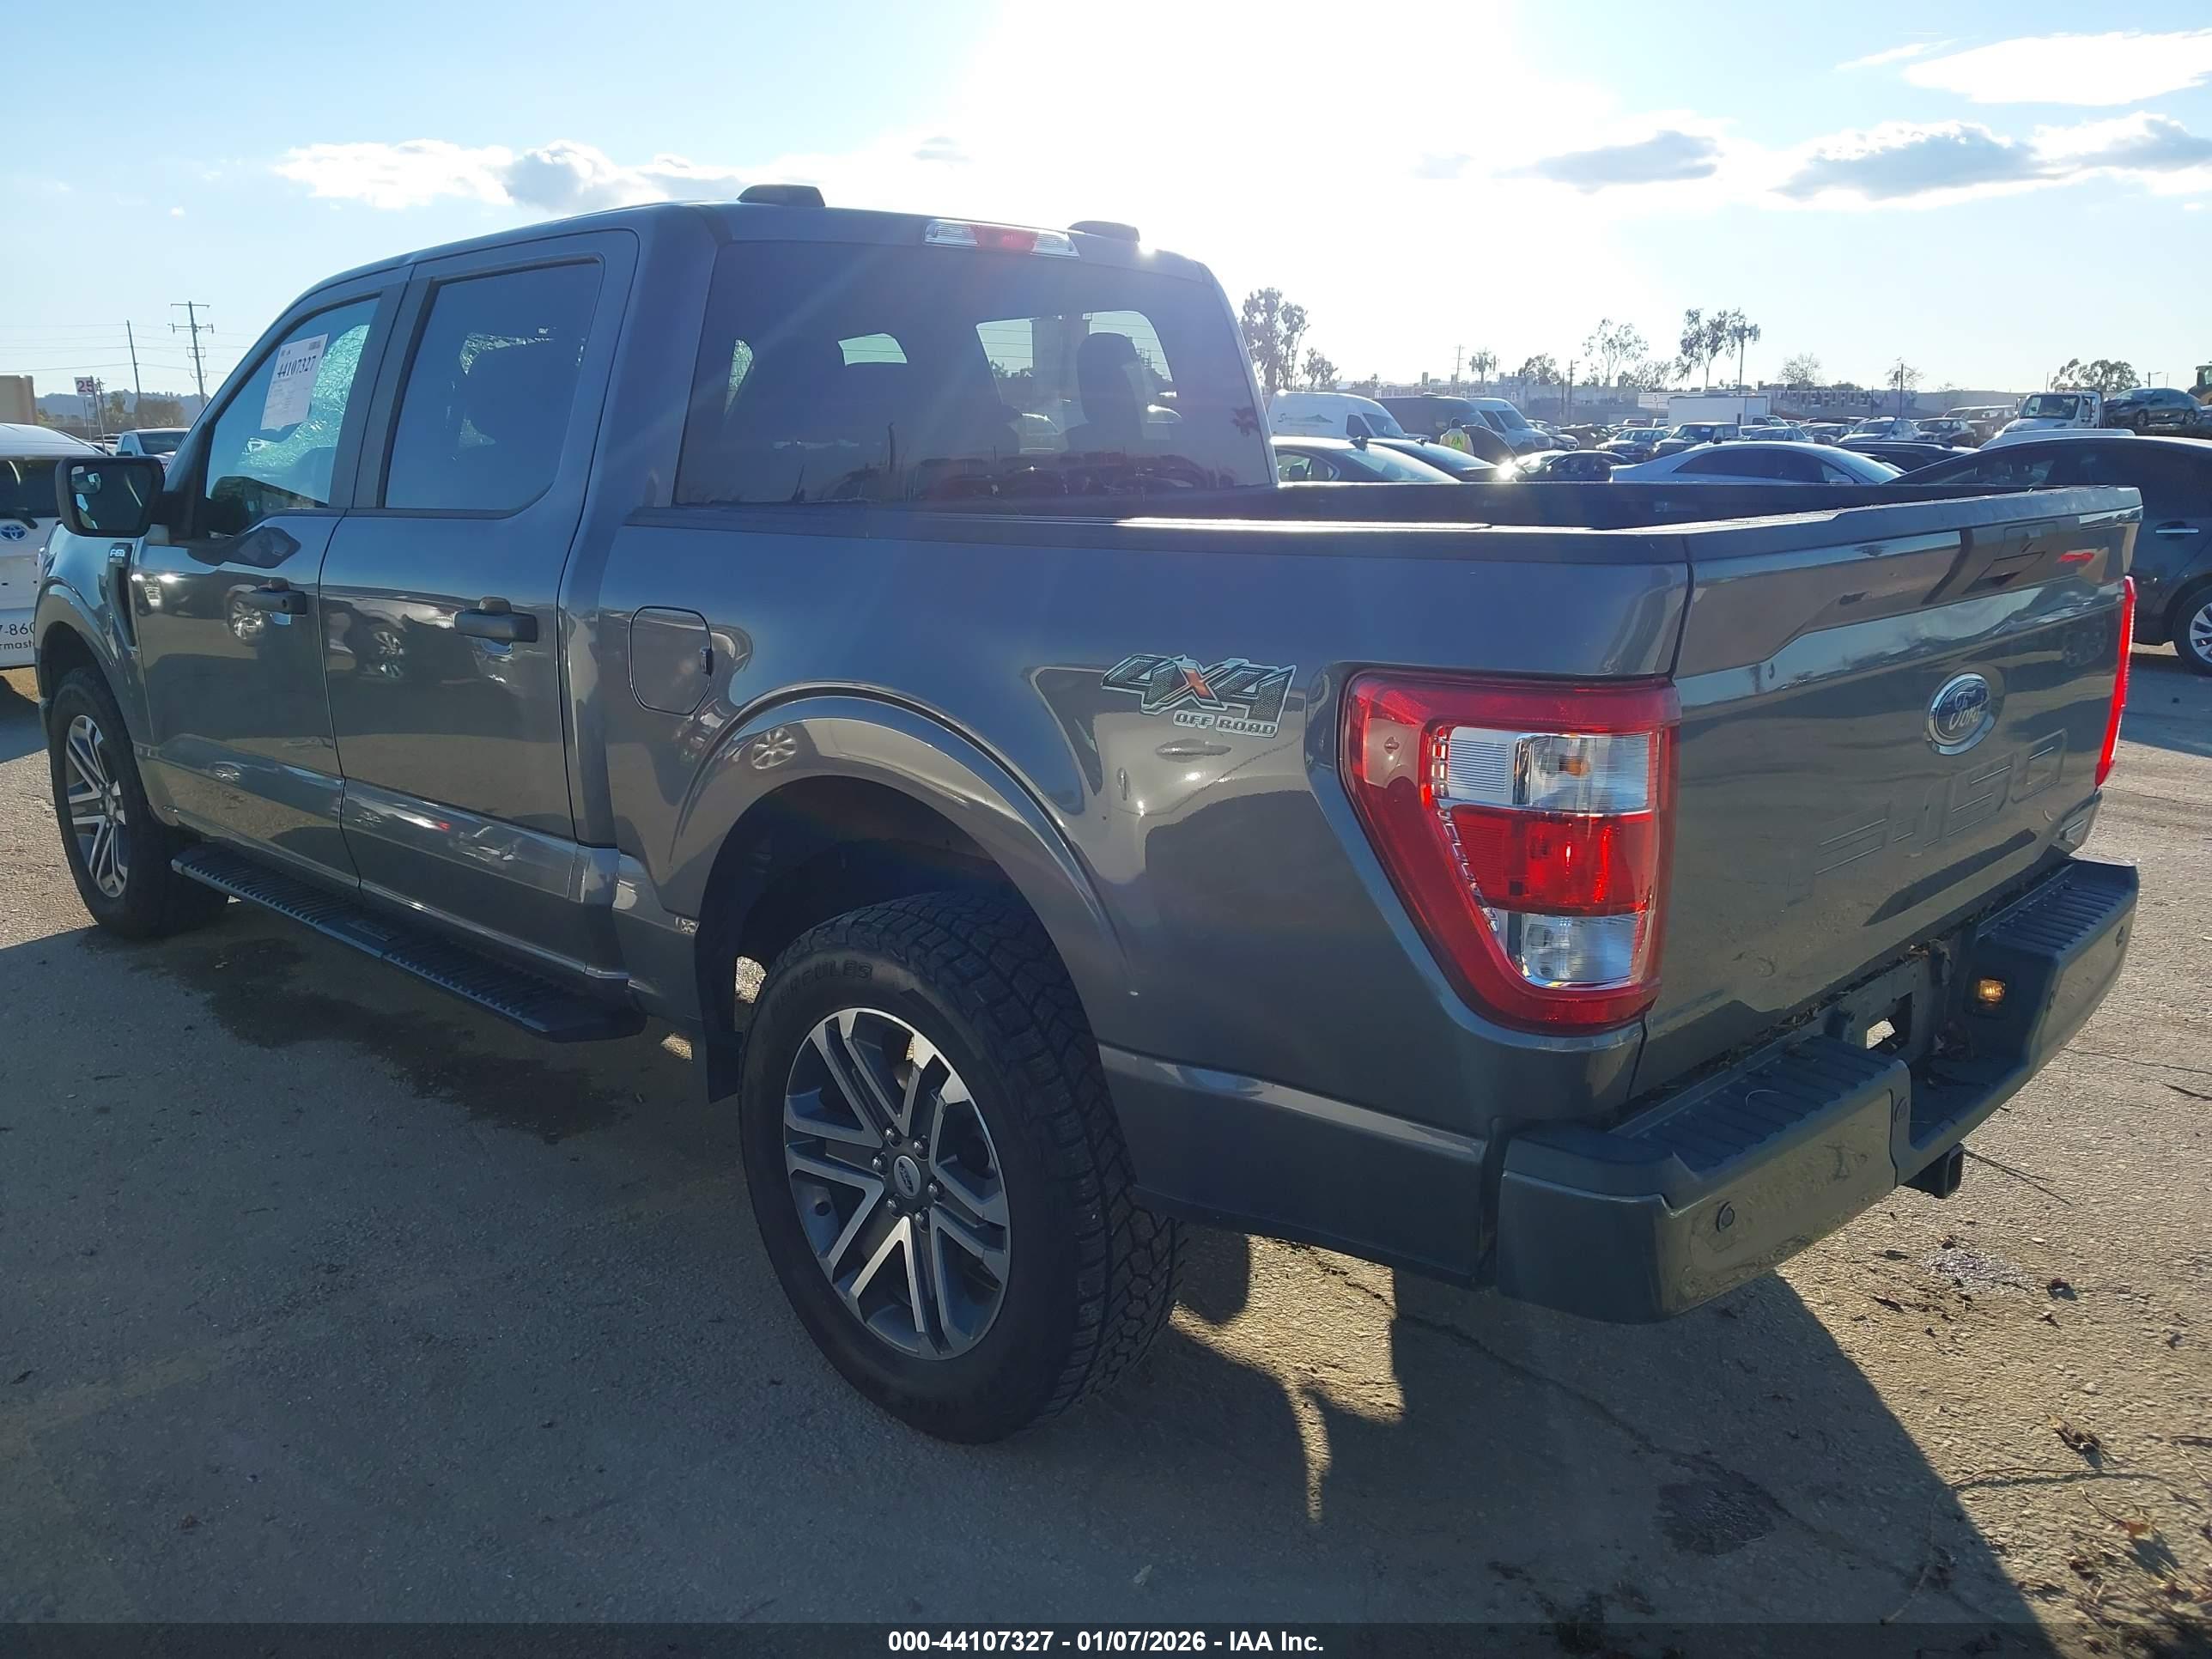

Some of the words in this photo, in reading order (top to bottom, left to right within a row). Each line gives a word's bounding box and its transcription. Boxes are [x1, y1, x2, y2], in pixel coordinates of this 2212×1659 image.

[277, 355, 317, 379] 44107327
[1173, 709, 1215, 729] OFF
[1215, 714, 1279, 738] ROAD
[1948, 689, 1986, 732] Ford
